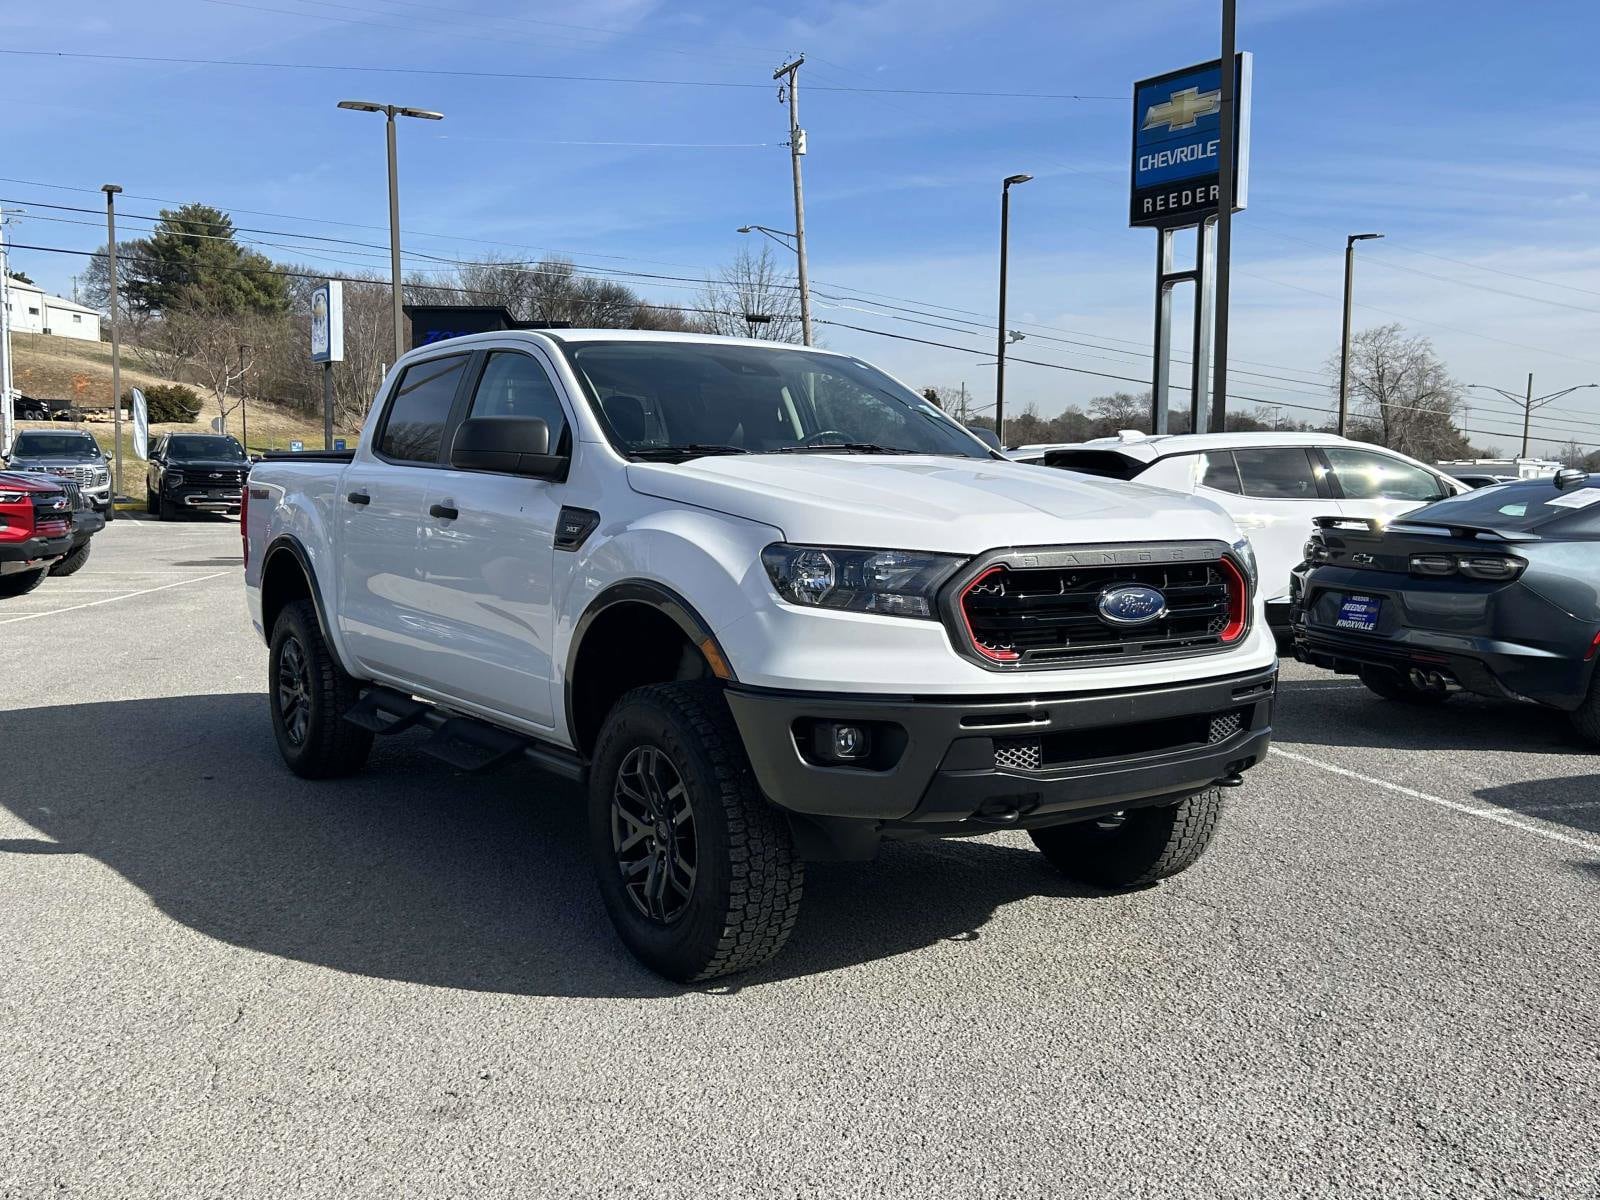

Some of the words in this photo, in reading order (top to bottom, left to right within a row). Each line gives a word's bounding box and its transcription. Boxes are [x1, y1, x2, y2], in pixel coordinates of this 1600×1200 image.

[1139, 139, 1220, 171] CHEVROLE
[1143, 184, 1219, 213] REEDER
[1024, 549, 1215, 566] RANGER
[1119, 593, 1154, 613] Ford
[1336, 619, 1375, 630] KNOXVILLE
